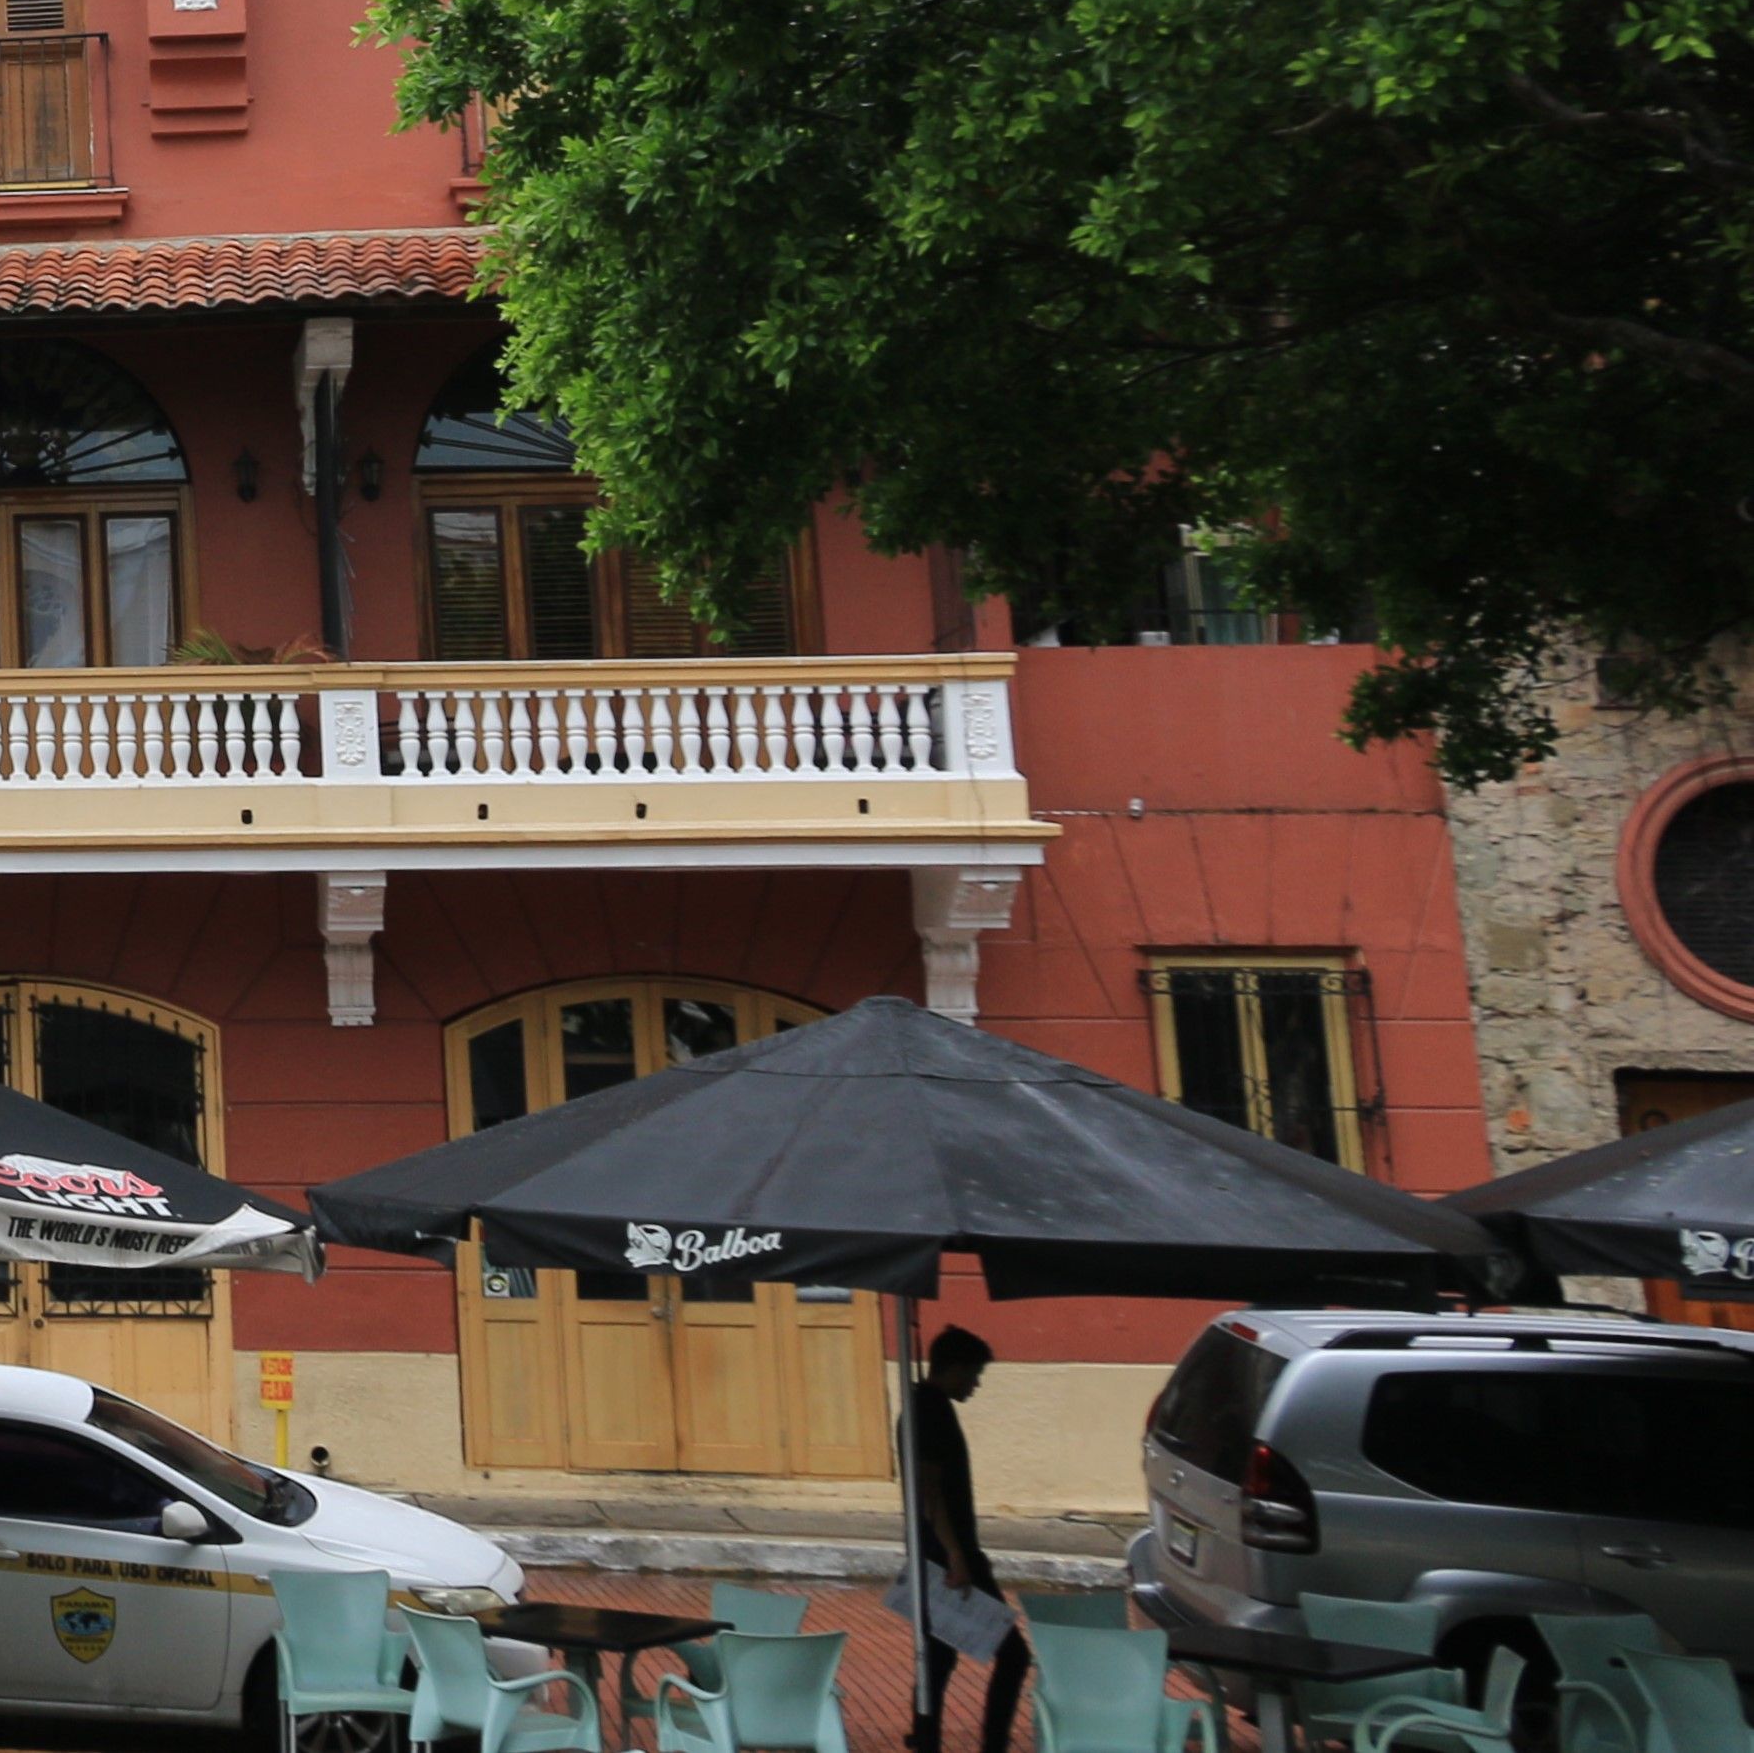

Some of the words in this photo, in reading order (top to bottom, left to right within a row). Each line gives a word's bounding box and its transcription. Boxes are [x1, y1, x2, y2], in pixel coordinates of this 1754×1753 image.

[17, 1187, 173, 1217] LIGHT
[8, 1216, 35, 1239] THE
[40, 1218, 111, 1245] WORLD'S
[114, 1226, 156, 1252] MOST
[673, 1228, 783, 1271] Balboa
[26, 1552, 67, 1571] SOLO
[72, 1557, 113, 1577] PARA
[119, 1561, 151, 1579] USO
[156, 1565, 217, 1587] OFICIAL
